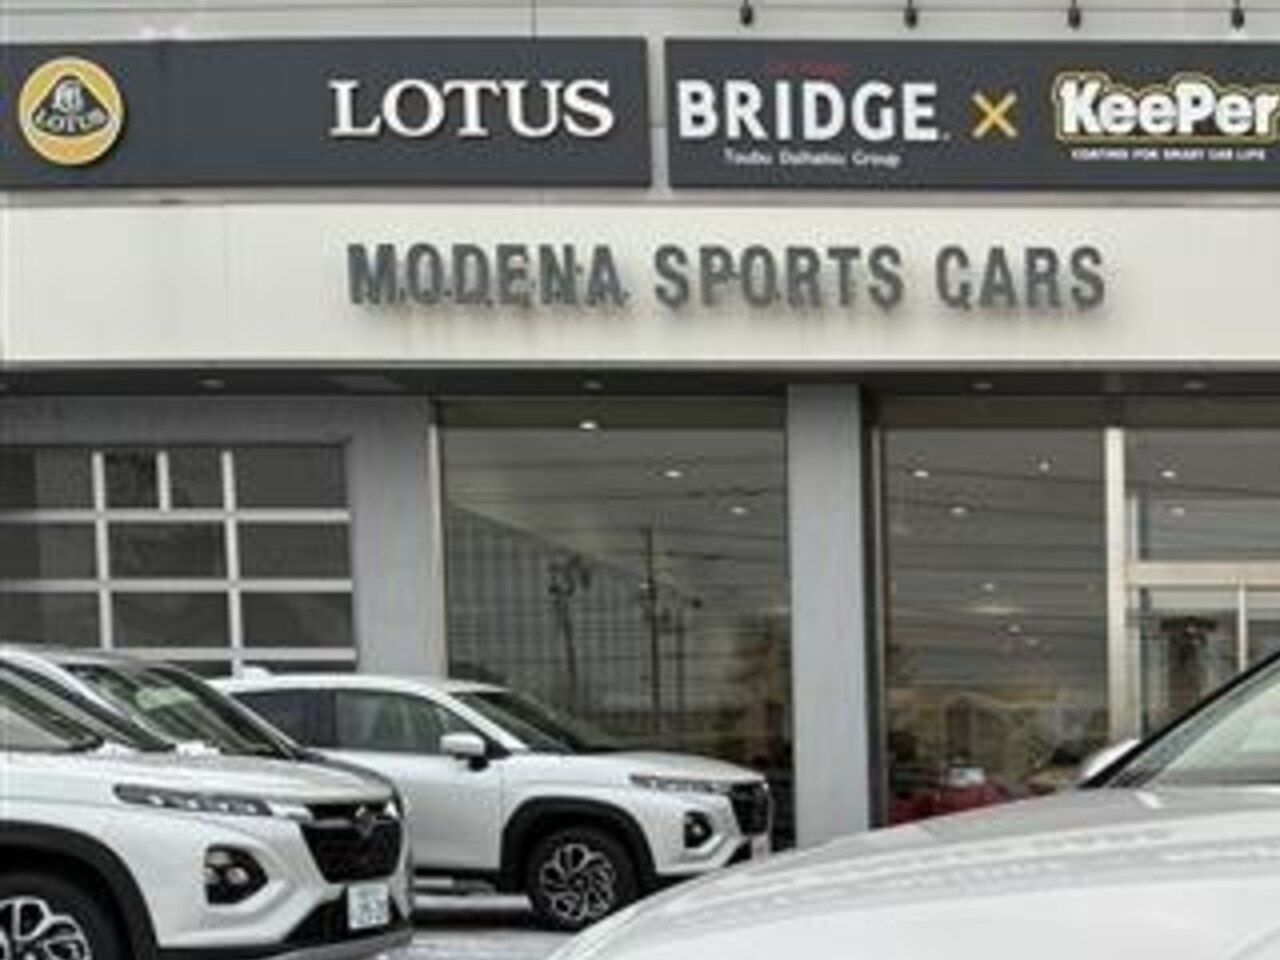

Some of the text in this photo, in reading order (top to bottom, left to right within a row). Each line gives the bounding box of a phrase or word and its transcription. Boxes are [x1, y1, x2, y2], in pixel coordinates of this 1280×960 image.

[328, 79, 614, 137] LOTUS
[677, 79, 939, 141] BRIDGE
[1060, 80, 1279, 134] KeePer
[347, 243, 1105, 310] MODENA SPORTS CARS
